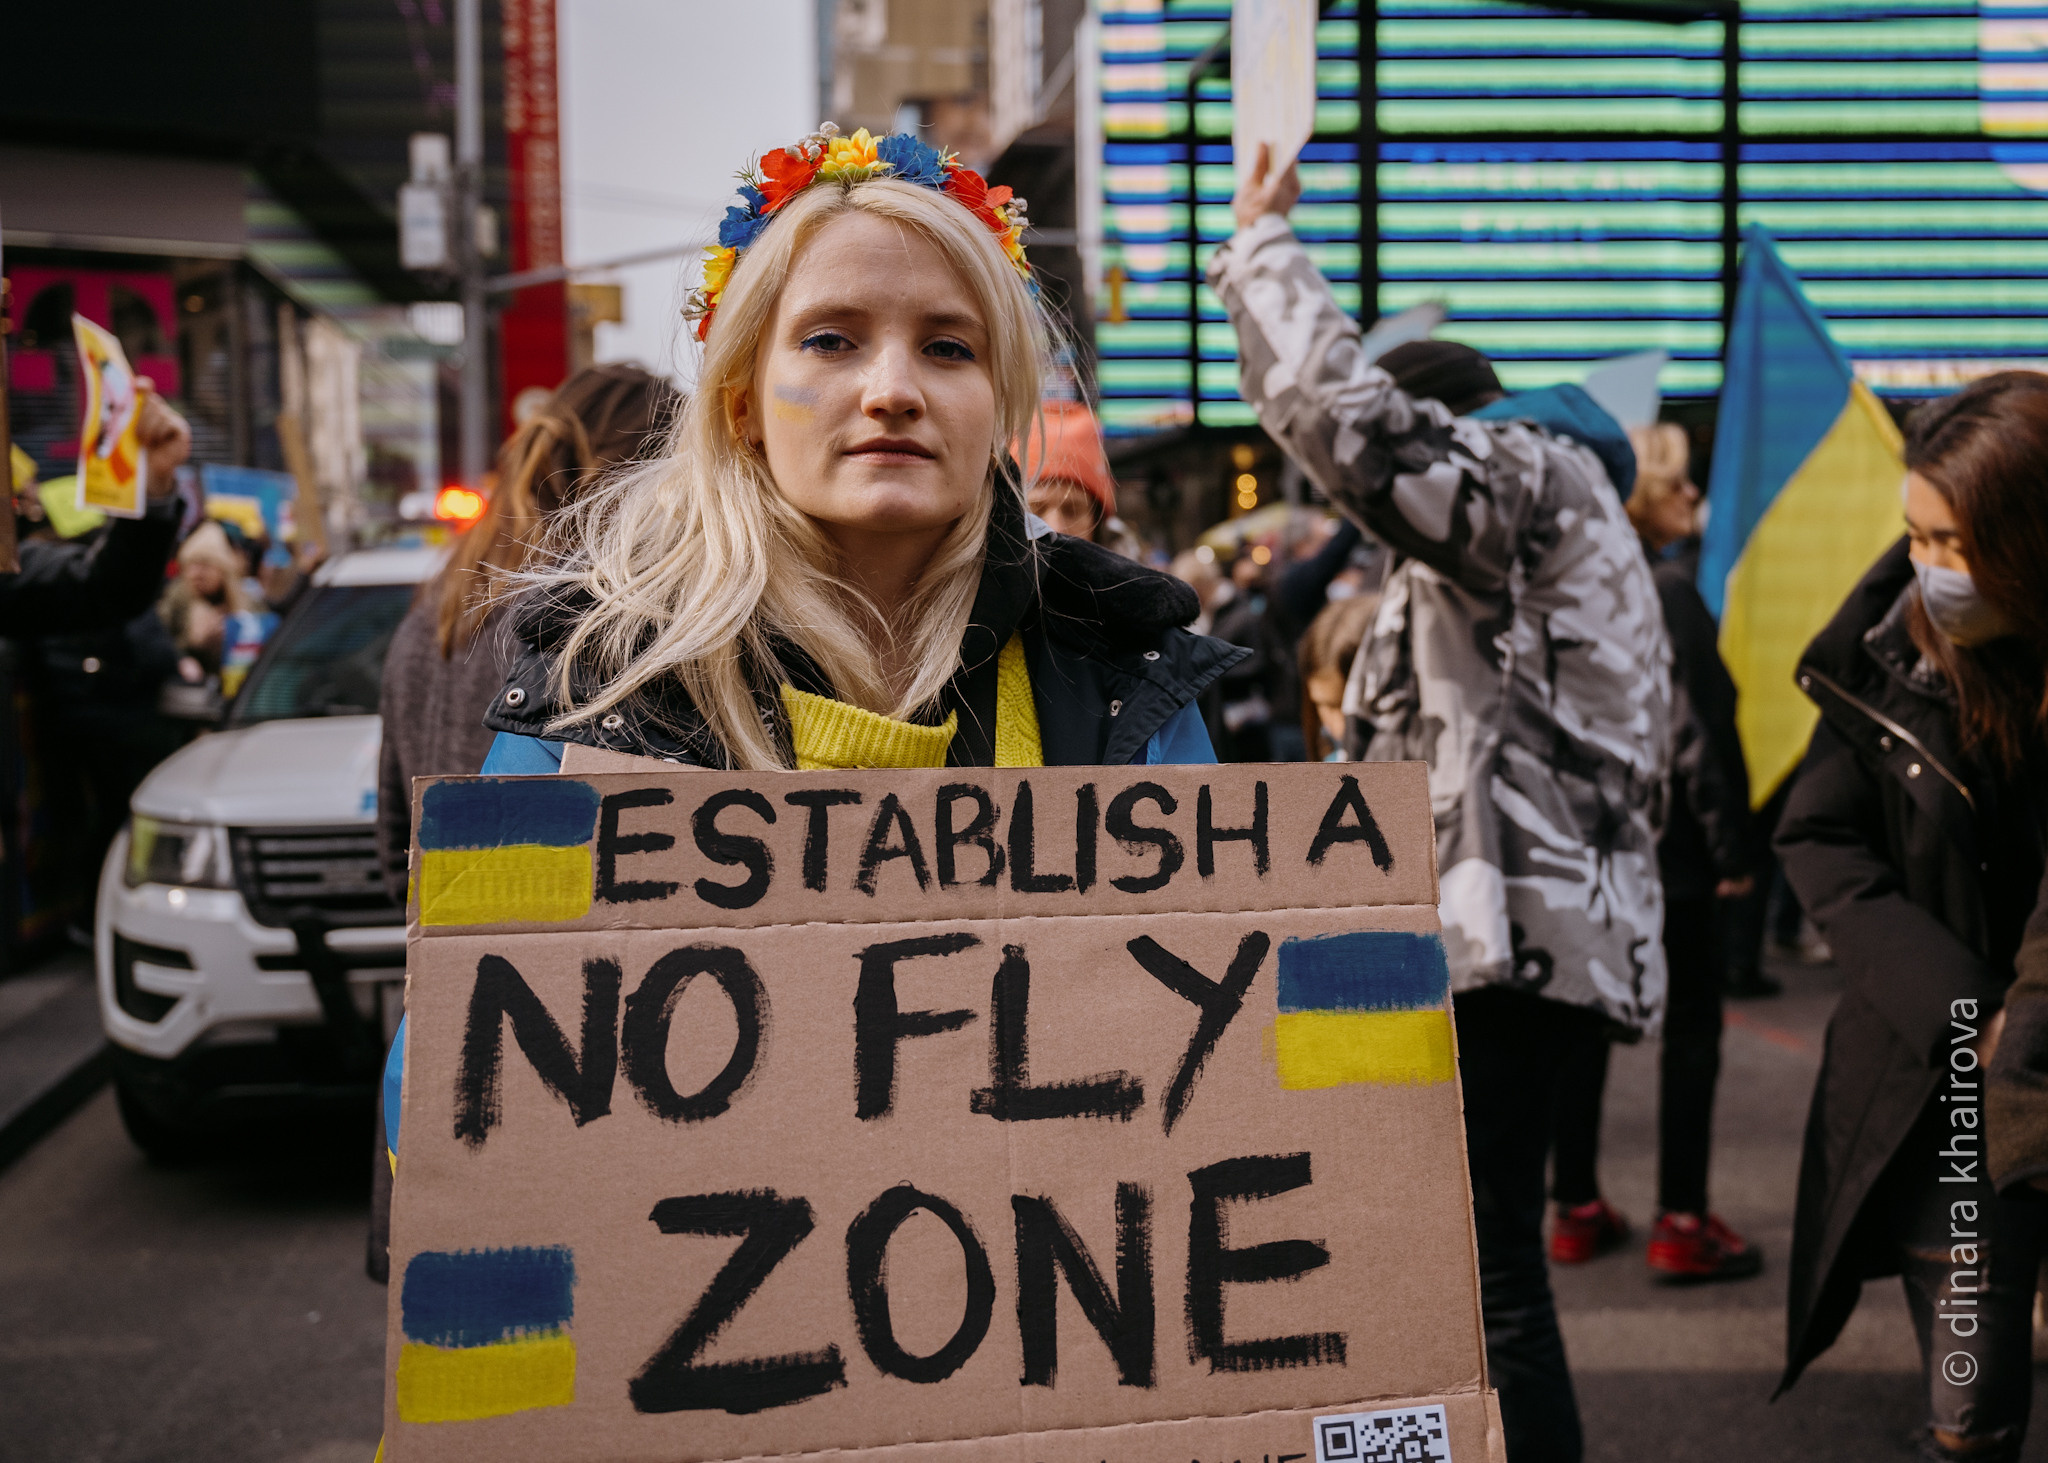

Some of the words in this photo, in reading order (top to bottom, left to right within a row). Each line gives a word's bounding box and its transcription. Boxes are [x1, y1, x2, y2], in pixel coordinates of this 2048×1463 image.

[595, 780, 1271, 909] ESTABLISH
[1306, 776, 1394, 872] A
[453, 945, 766, 1145] NO
[853, 931, 1270, 1137] FLY
[629, 1152, 1346, 1415] ZONE
